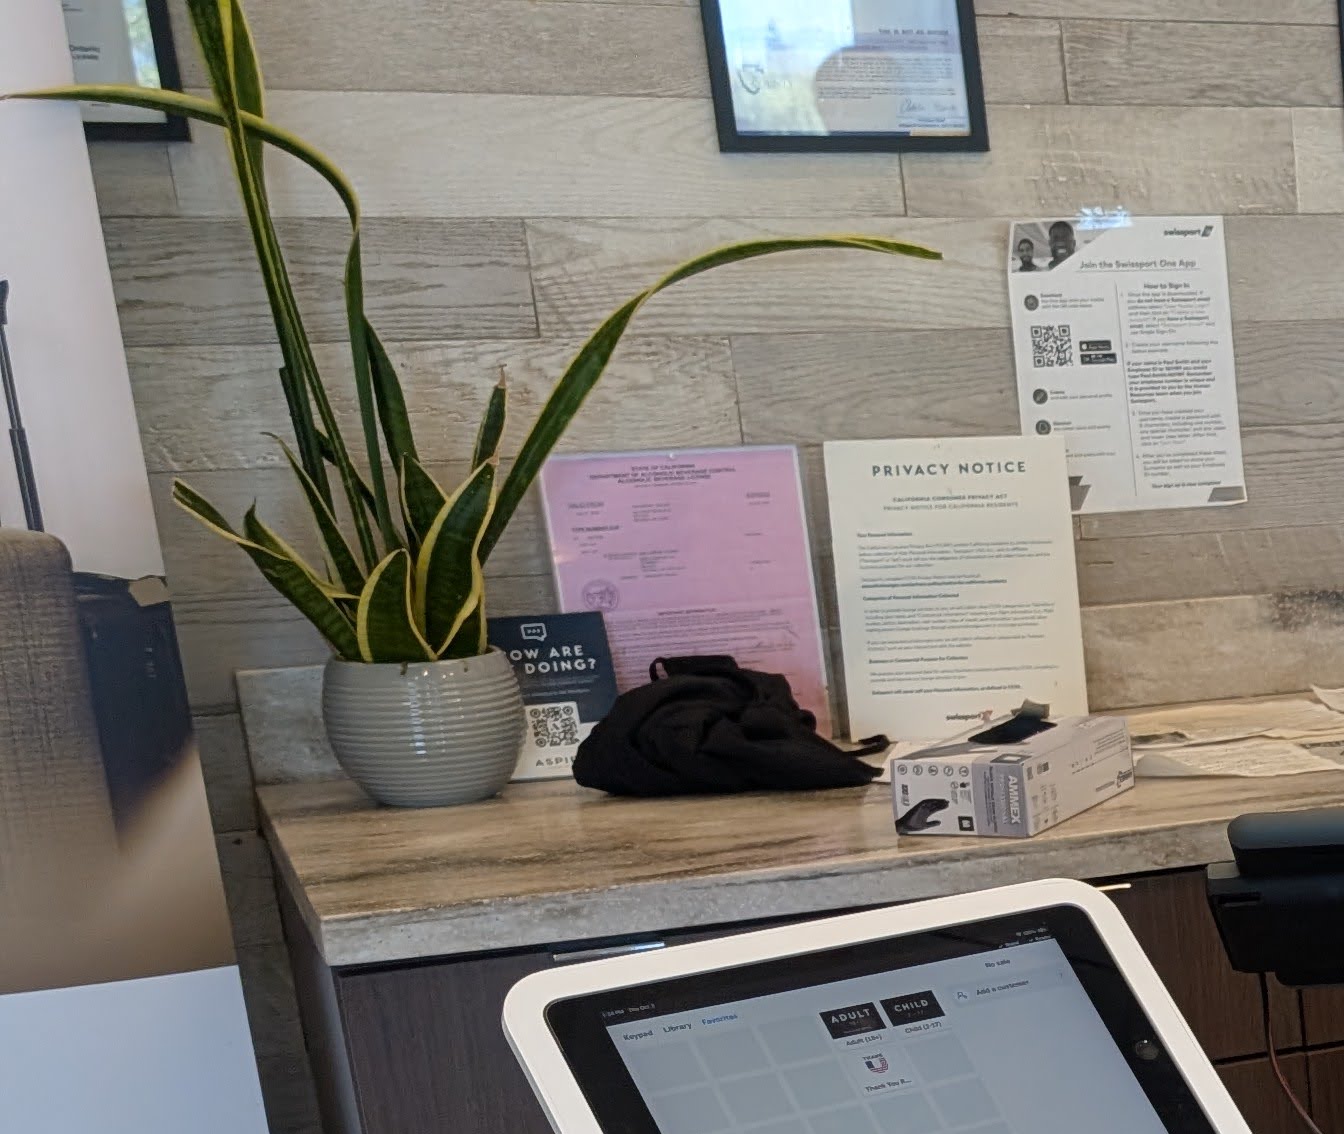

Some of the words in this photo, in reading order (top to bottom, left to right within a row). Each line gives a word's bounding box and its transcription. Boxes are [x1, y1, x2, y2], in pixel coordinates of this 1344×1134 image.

[1099, 260, 1113, 269] the
[1159, 259, 1177, 268] One
[1178, 259, 1196, 269] App
[871, 463, 950, 477] PRIVACY
[958, 461, 1026, 474] NOTICE
[510, 648, 540, 661] OW
[550, 644, 584, 657] ARE
[524, 657, 596, 674] DOING?
[535, 756, 575, 767] ASPI
[894, 999, 929, 1012] CHILD
[831, 1008, 870, 1024] ADULT
[622, 1030, 653, 1041] Keypad
[662, 1022, 692, 1033] Library
